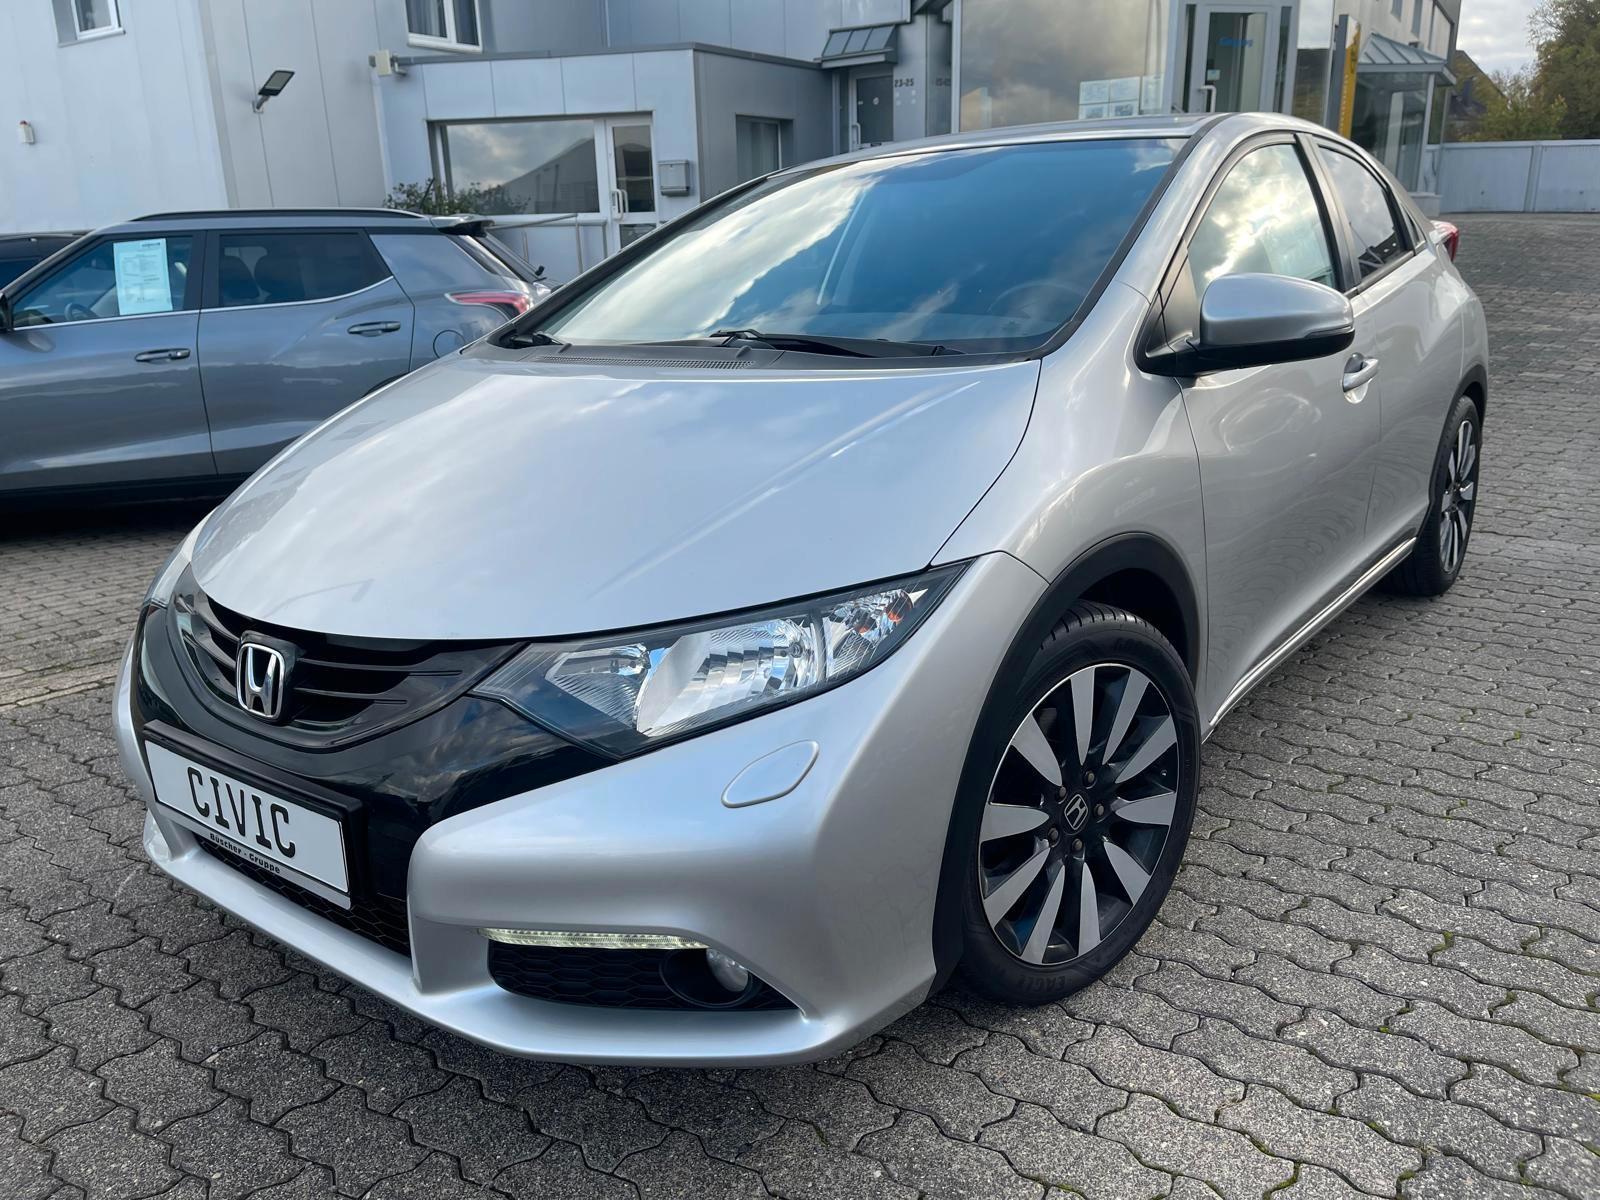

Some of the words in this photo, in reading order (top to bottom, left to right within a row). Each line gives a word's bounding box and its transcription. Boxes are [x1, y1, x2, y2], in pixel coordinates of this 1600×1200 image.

[187, 766, 296, 859] CIVIC
[209, 832, 243, 855] Büscher
[249, 852, 281, 874] Gruppe
